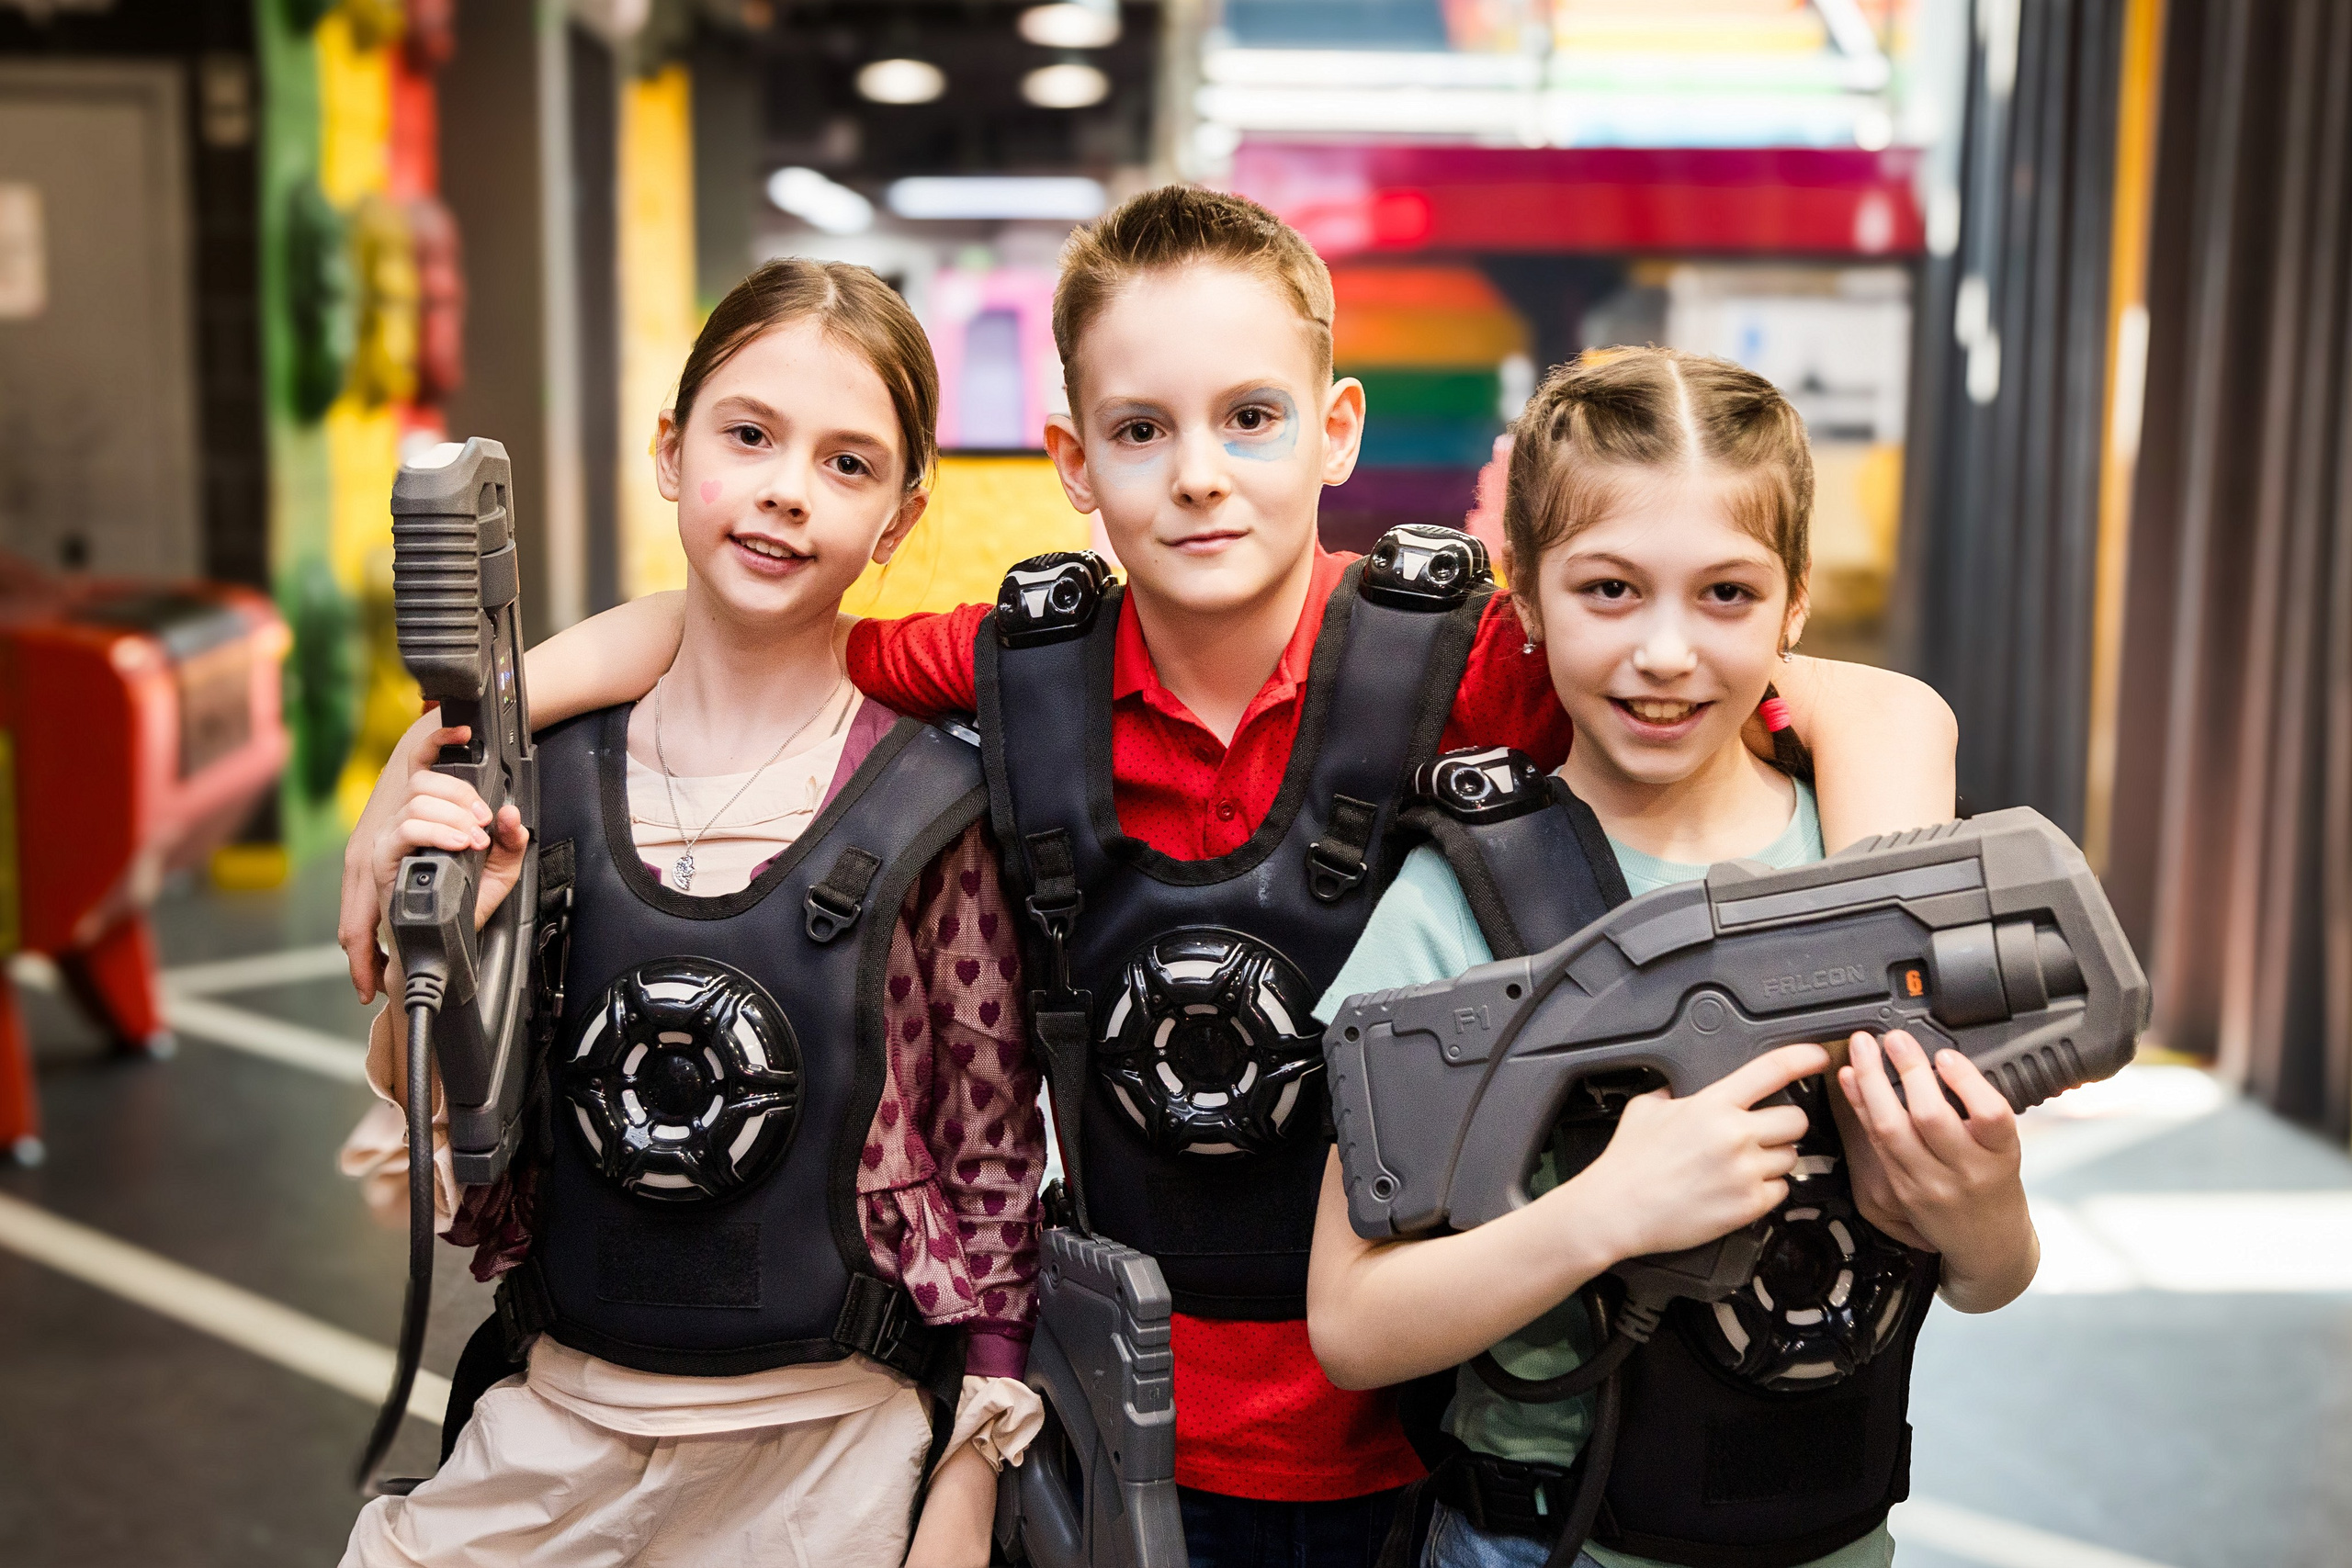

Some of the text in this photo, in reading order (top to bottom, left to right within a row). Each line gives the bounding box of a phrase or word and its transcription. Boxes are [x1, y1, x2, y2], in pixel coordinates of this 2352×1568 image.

[1762, 964, 1866, 998] FALCON
[1905, 969, 1923, 996] 6
[1453, 1005, 1490, 1034] F1
